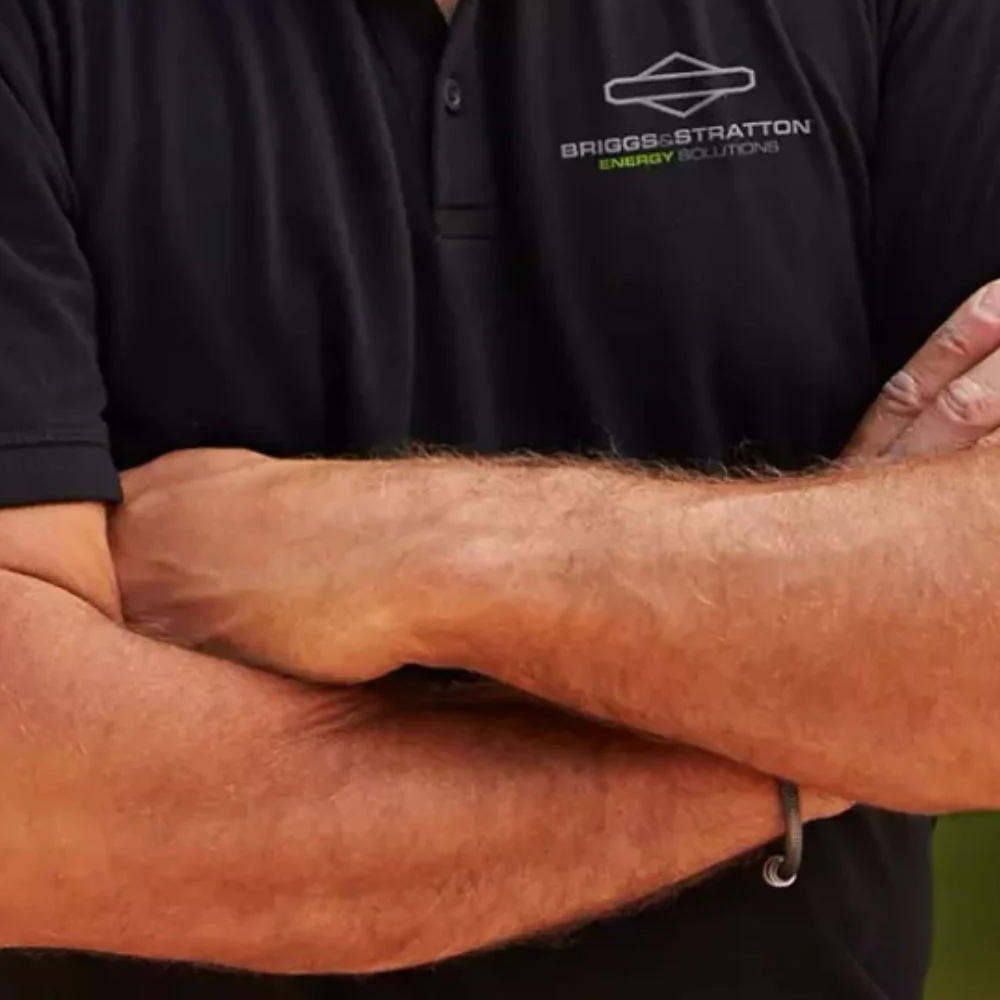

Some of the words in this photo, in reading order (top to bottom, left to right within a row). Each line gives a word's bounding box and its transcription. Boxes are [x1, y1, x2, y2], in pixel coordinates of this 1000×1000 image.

[560, 119, 811, 159] BRIGGS&STRATTON
[598, 151, 675, 170] ENERGY
[677, 139, 780, 163] SOLUTIONS
